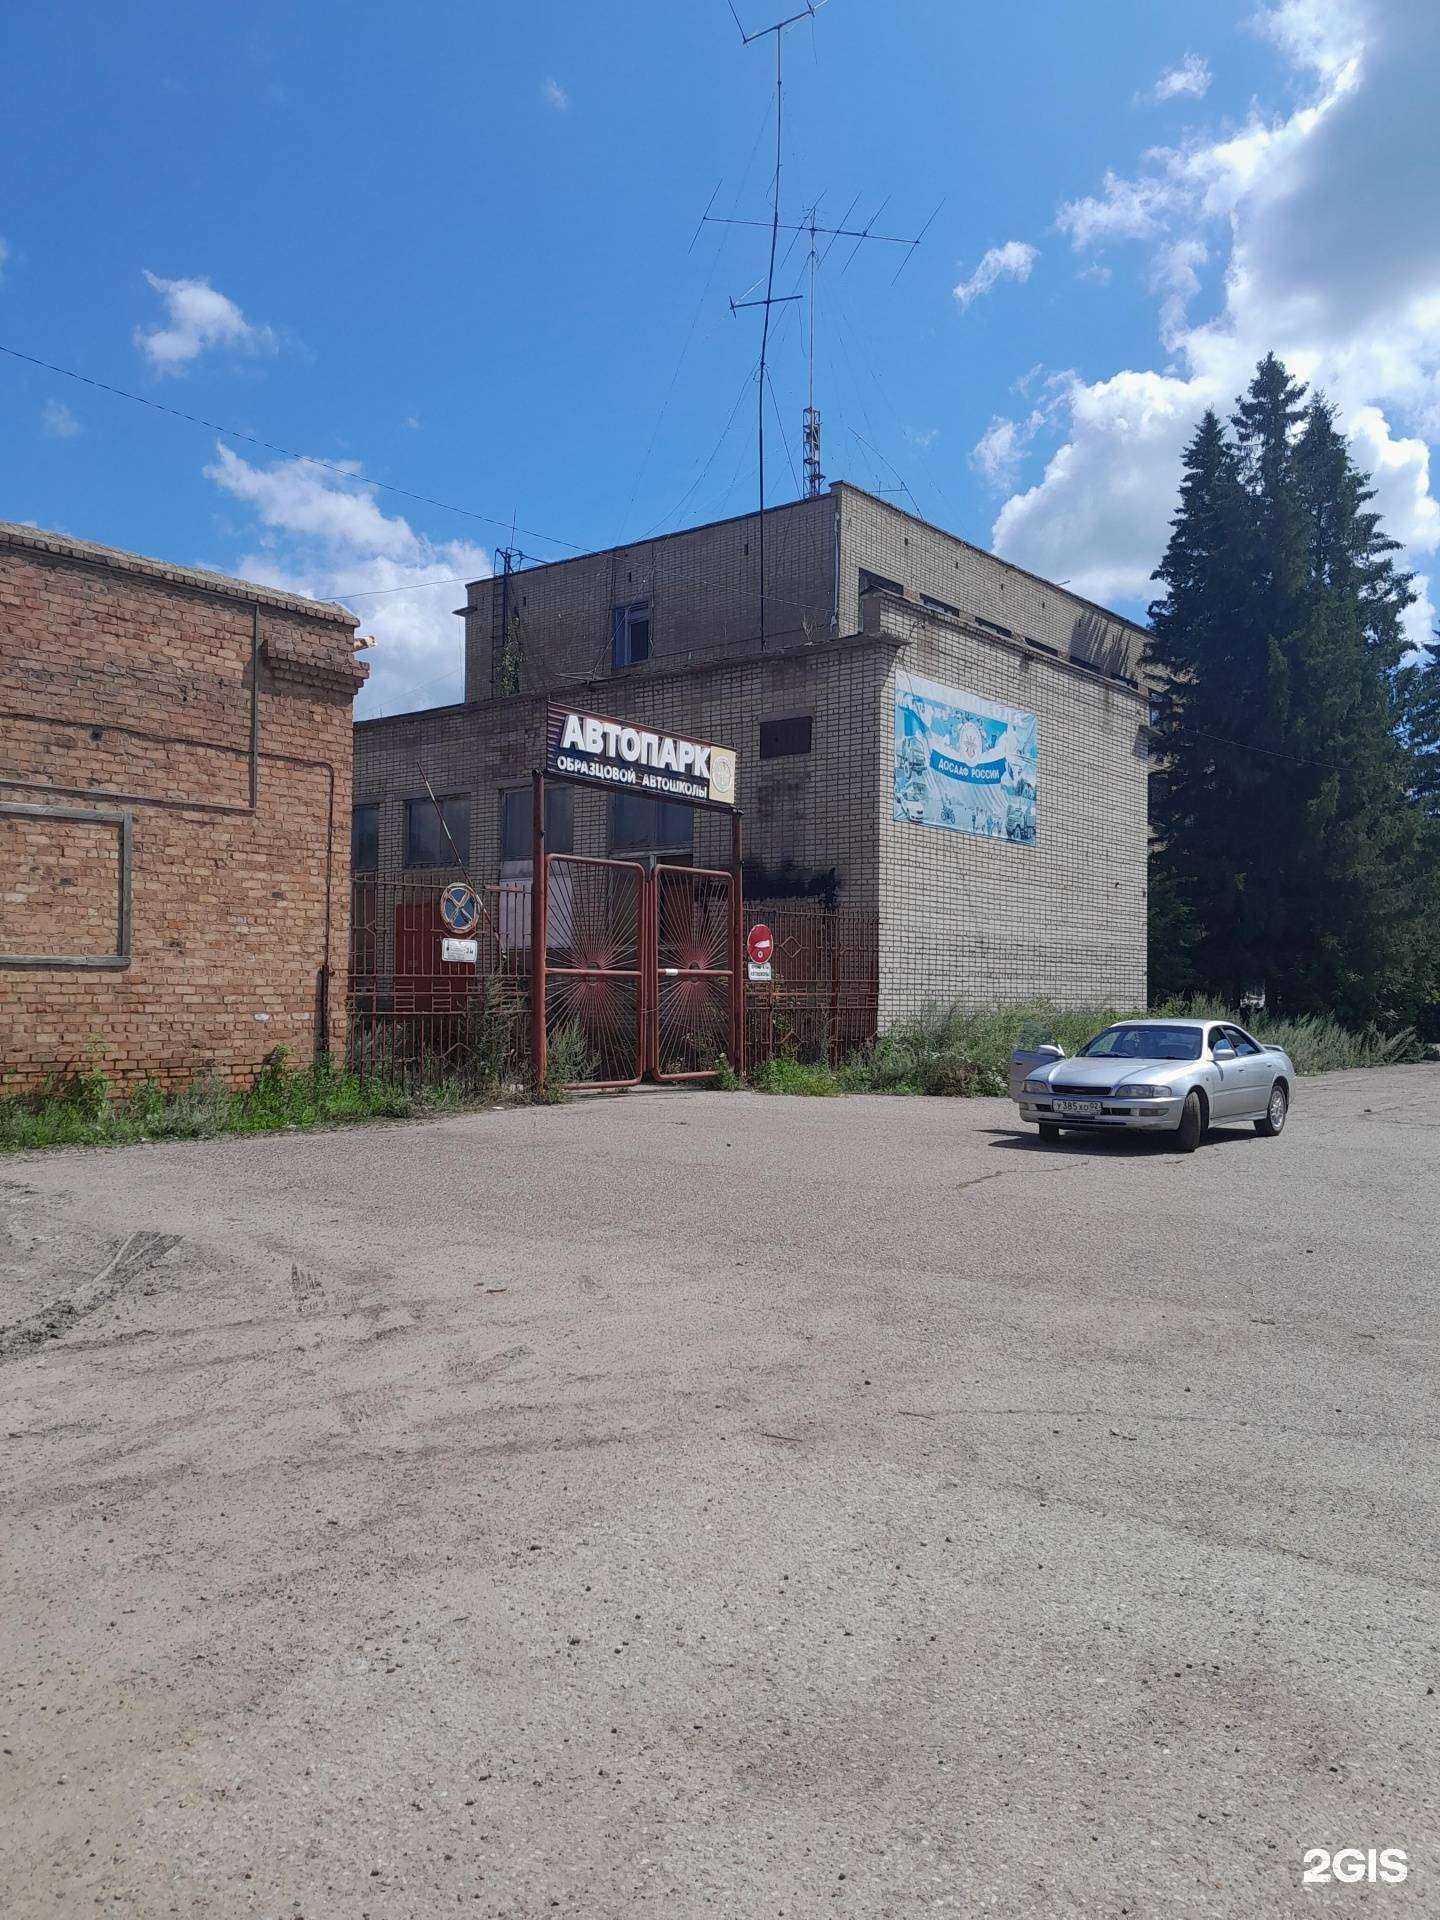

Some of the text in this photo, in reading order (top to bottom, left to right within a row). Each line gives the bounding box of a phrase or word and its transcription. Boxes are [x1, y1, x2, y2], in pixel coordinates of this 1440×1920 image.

[561, 715, 711, 778] АВТОПАРК
[557, 756, 708, 798] ОБРАЗЦОВОЙ АВТОШКОЛЫ
[971, 768, 1000, 779] РОССИИ
